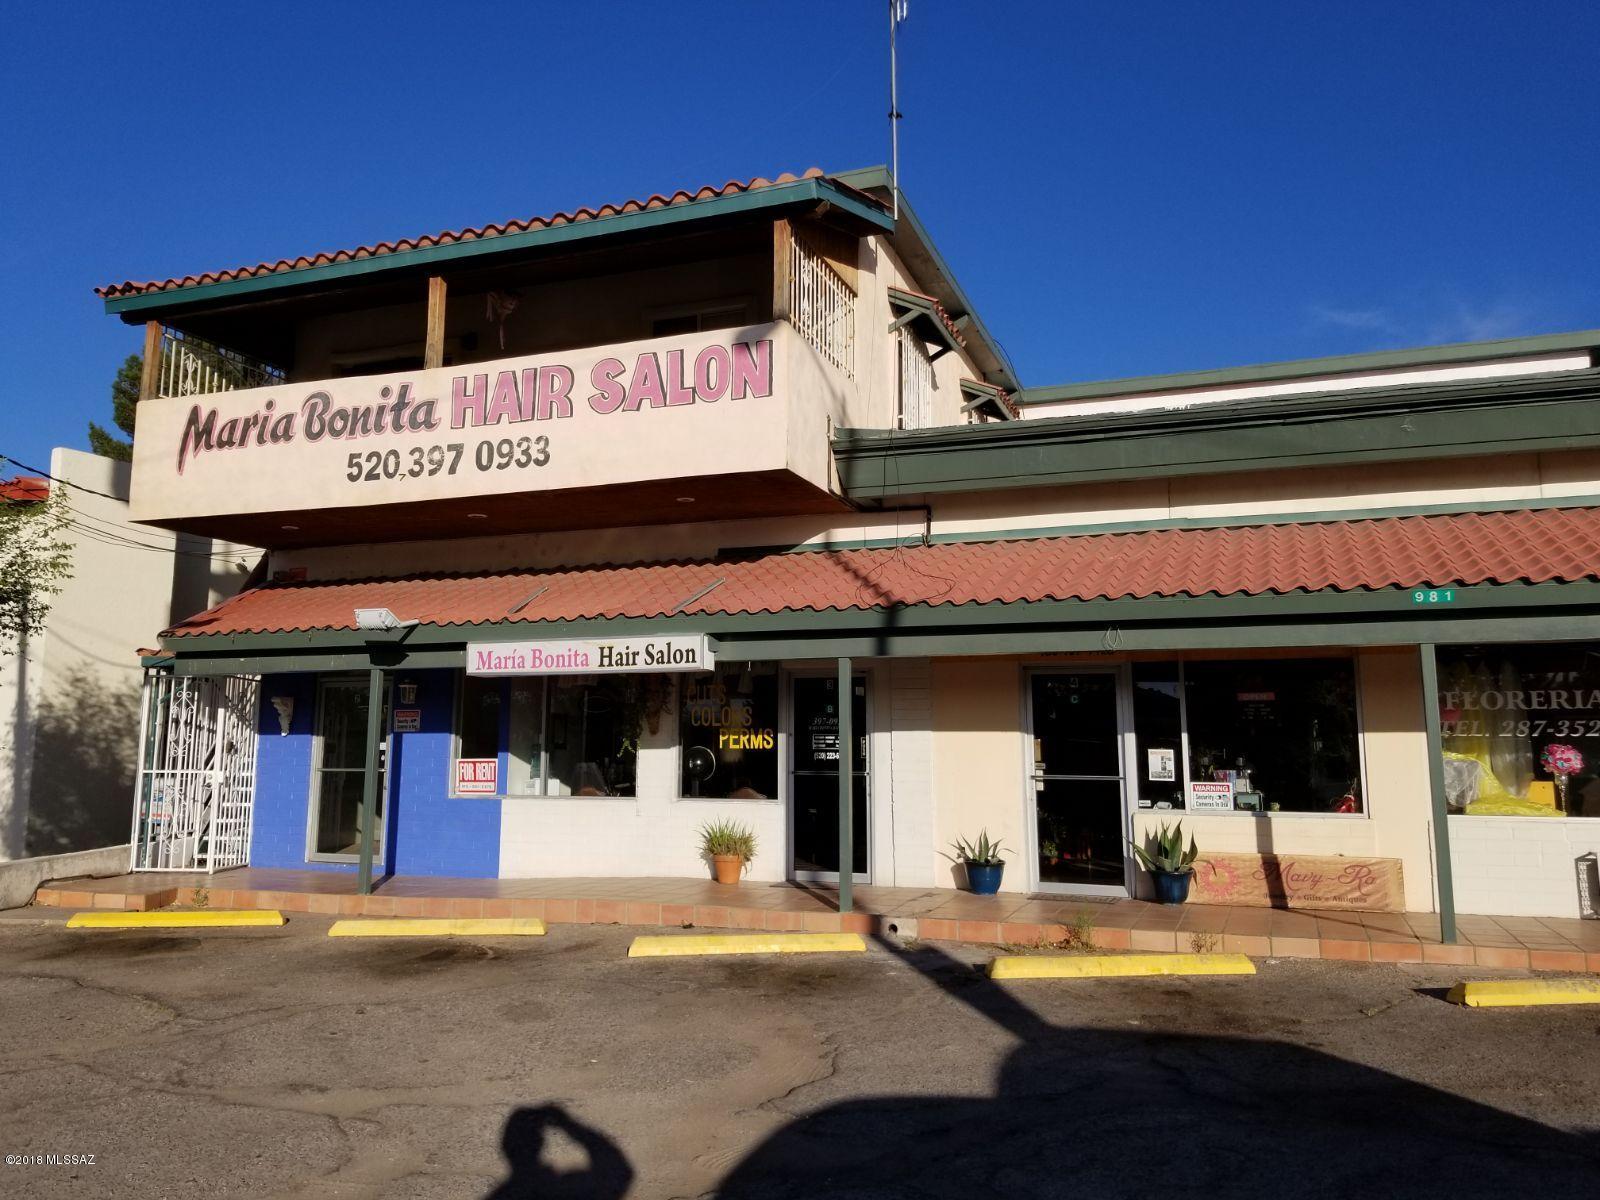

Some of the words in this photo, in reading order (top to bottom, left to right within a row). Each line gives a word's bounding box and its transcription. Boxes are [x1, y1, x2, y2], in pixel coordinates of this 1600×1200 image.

[177, 398, 297, 475] Maria
[301, 382, 440, 441] Bonita
[450, 364, 575, 430] HAIR
[587, 339, 773, 416] SALON
[475, 434, 550, 472] 0933
[475, 648, 526, 671] María
[530, 648, 590, 669] Bonita
[598, 645, 640, 668] Hair
[643, 641, 697, 665] Salon
[1444, 689, 1600, 711] FLORERIA
[719, 729, 774, 750] PERMS
[459, 762, 475, 781] FOR
[475, 762, 496, 781] RENT
[1194, 784, 1228, 792] WARNING
